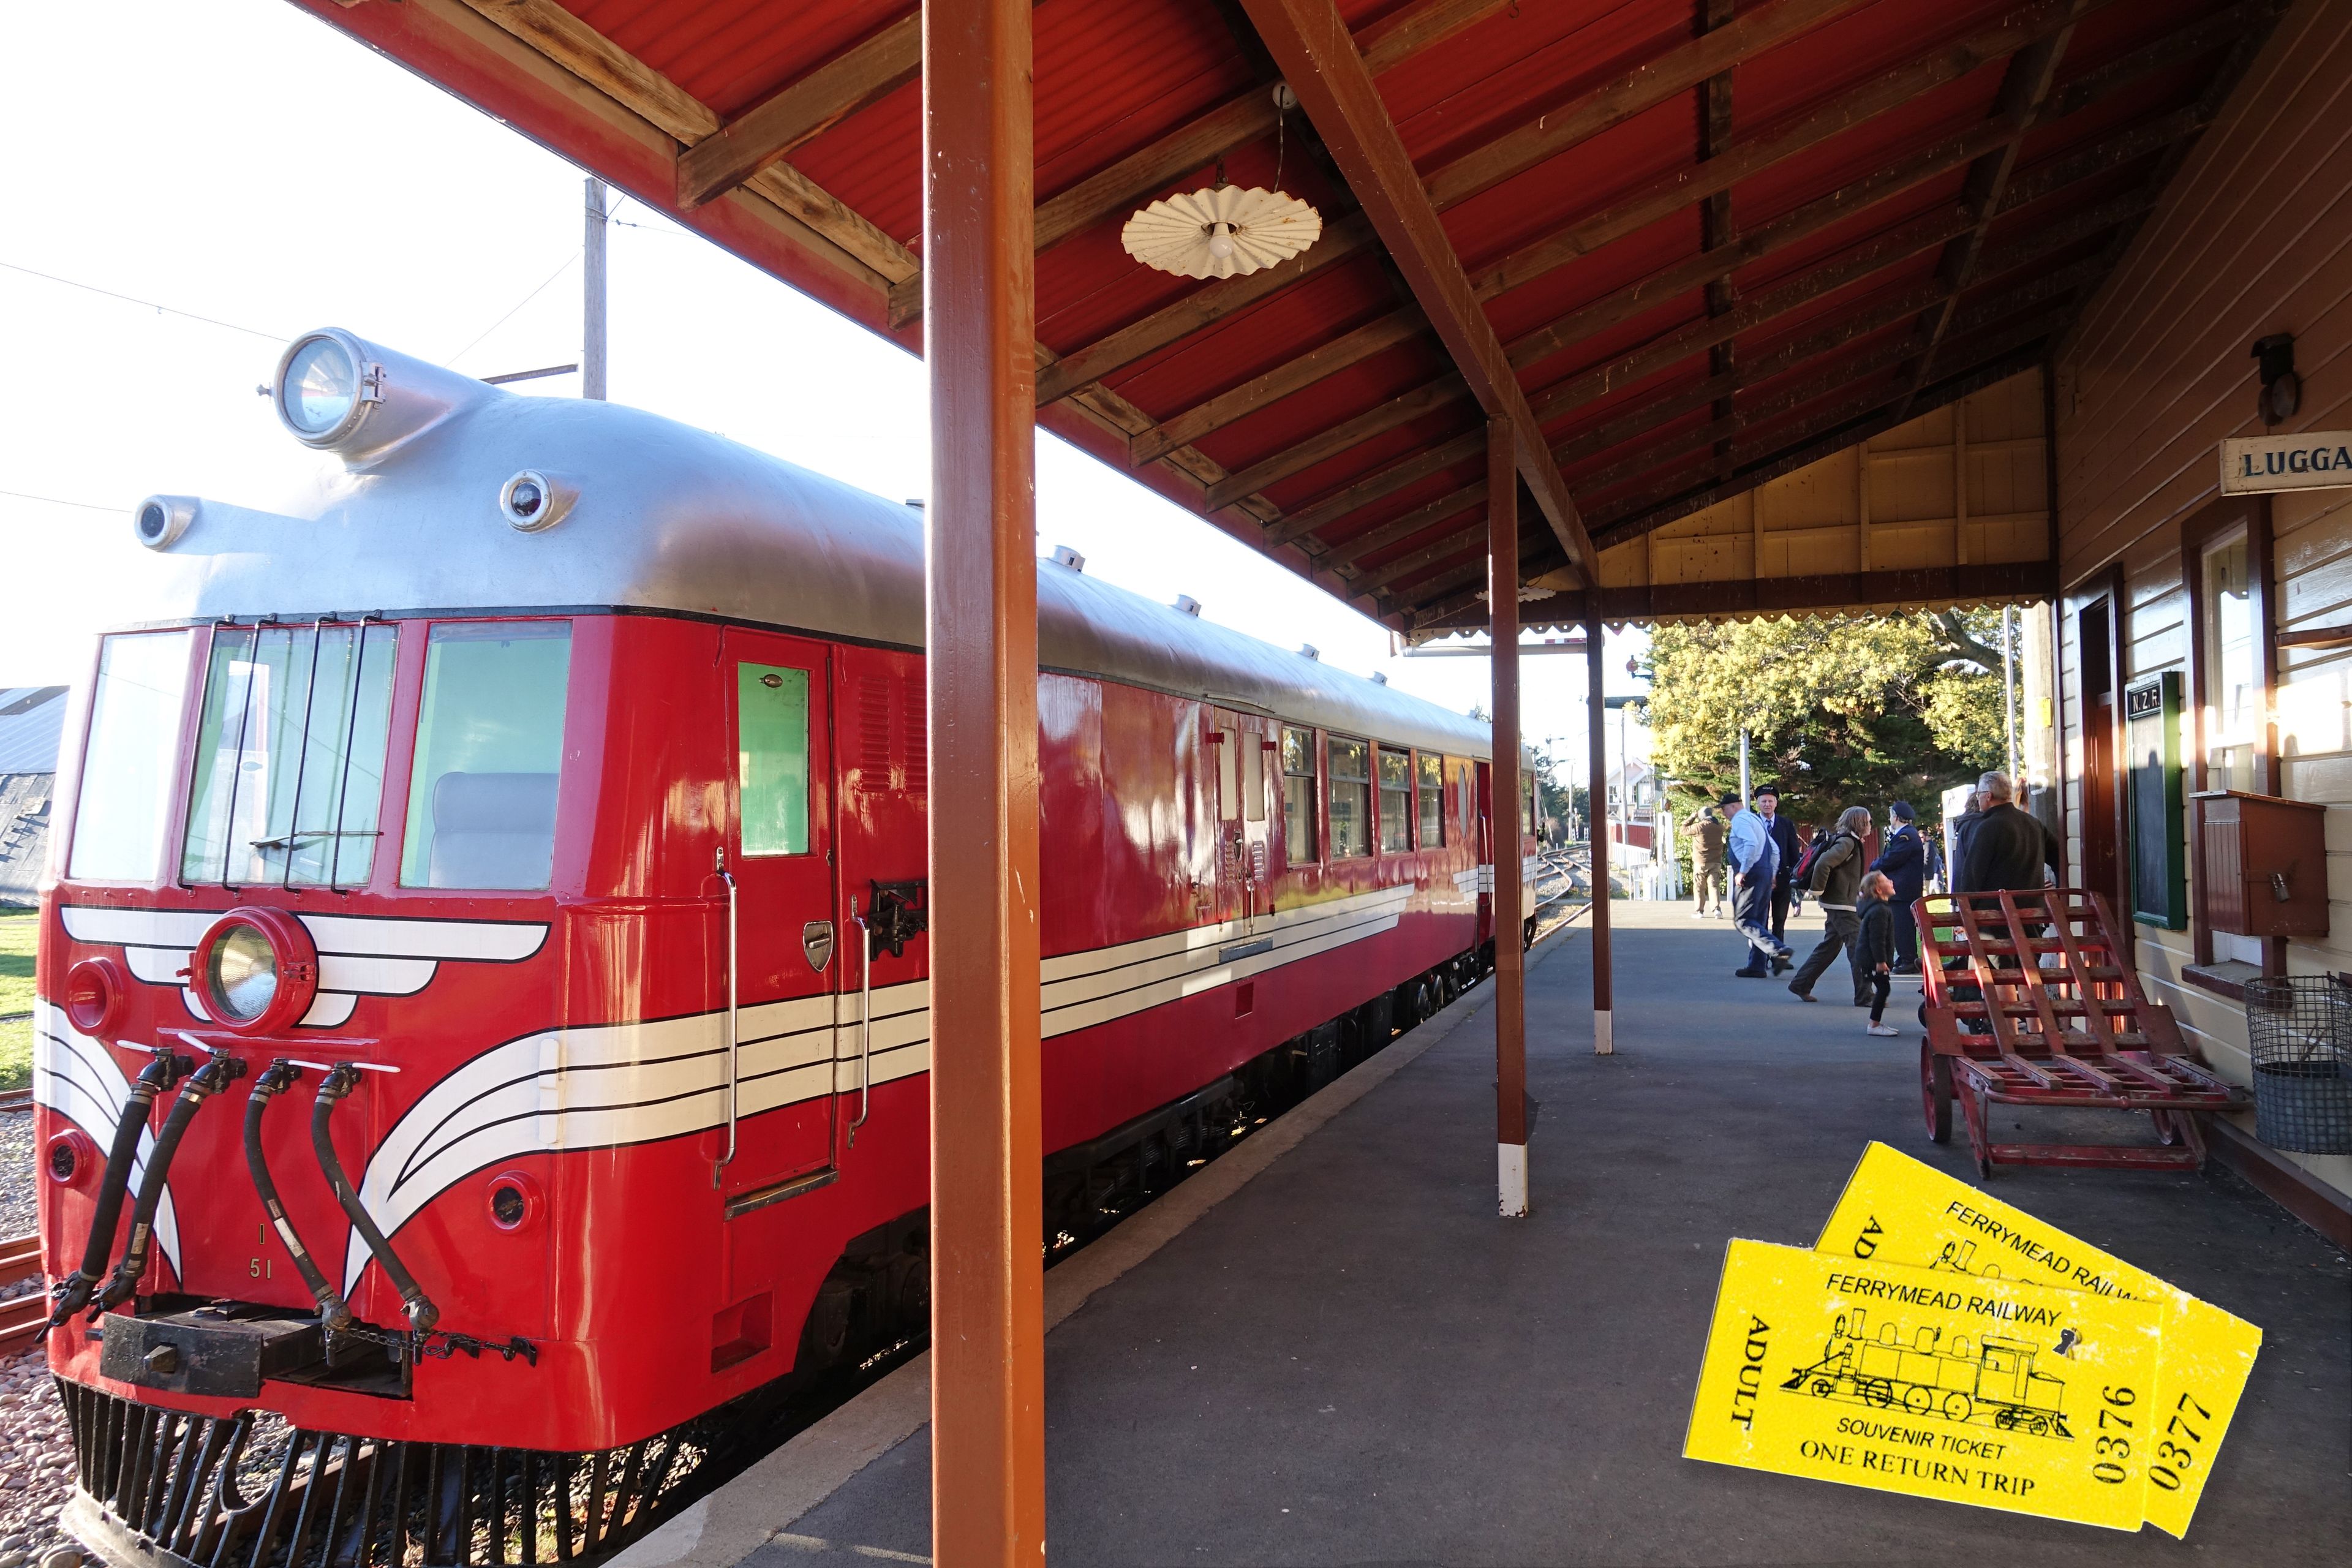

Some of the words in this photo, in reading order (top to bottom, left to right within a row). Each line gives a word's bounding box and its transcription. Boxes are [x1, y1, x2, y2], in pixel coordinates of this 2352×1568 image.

[2244, 446, 2352, 477] LUGGA
[1945, 1200, 2071, 1273] FERRYMEAD
[250, 1257, 271, 1280] 51
[1826, 1273, 1961, 1311] FERRYMEAD
[1967, 1295, 2063, 1328] RAILWAY
[1730, 1314, 1771, 1431] ADULT
[1838, 1417, 1934, 1448] SOUVENIR
[1940, 1434, 2007, 1460] TICKET
[2092, 1385, 2136, 1484] 0376
[2148, 1392, 2211, 1491] 0377
[1800, 1440, 1855, 1465] ONE
[1862, 1450, 1969, 1485] RETURN
[1977, 1470, 2035, 1496] TRIP
